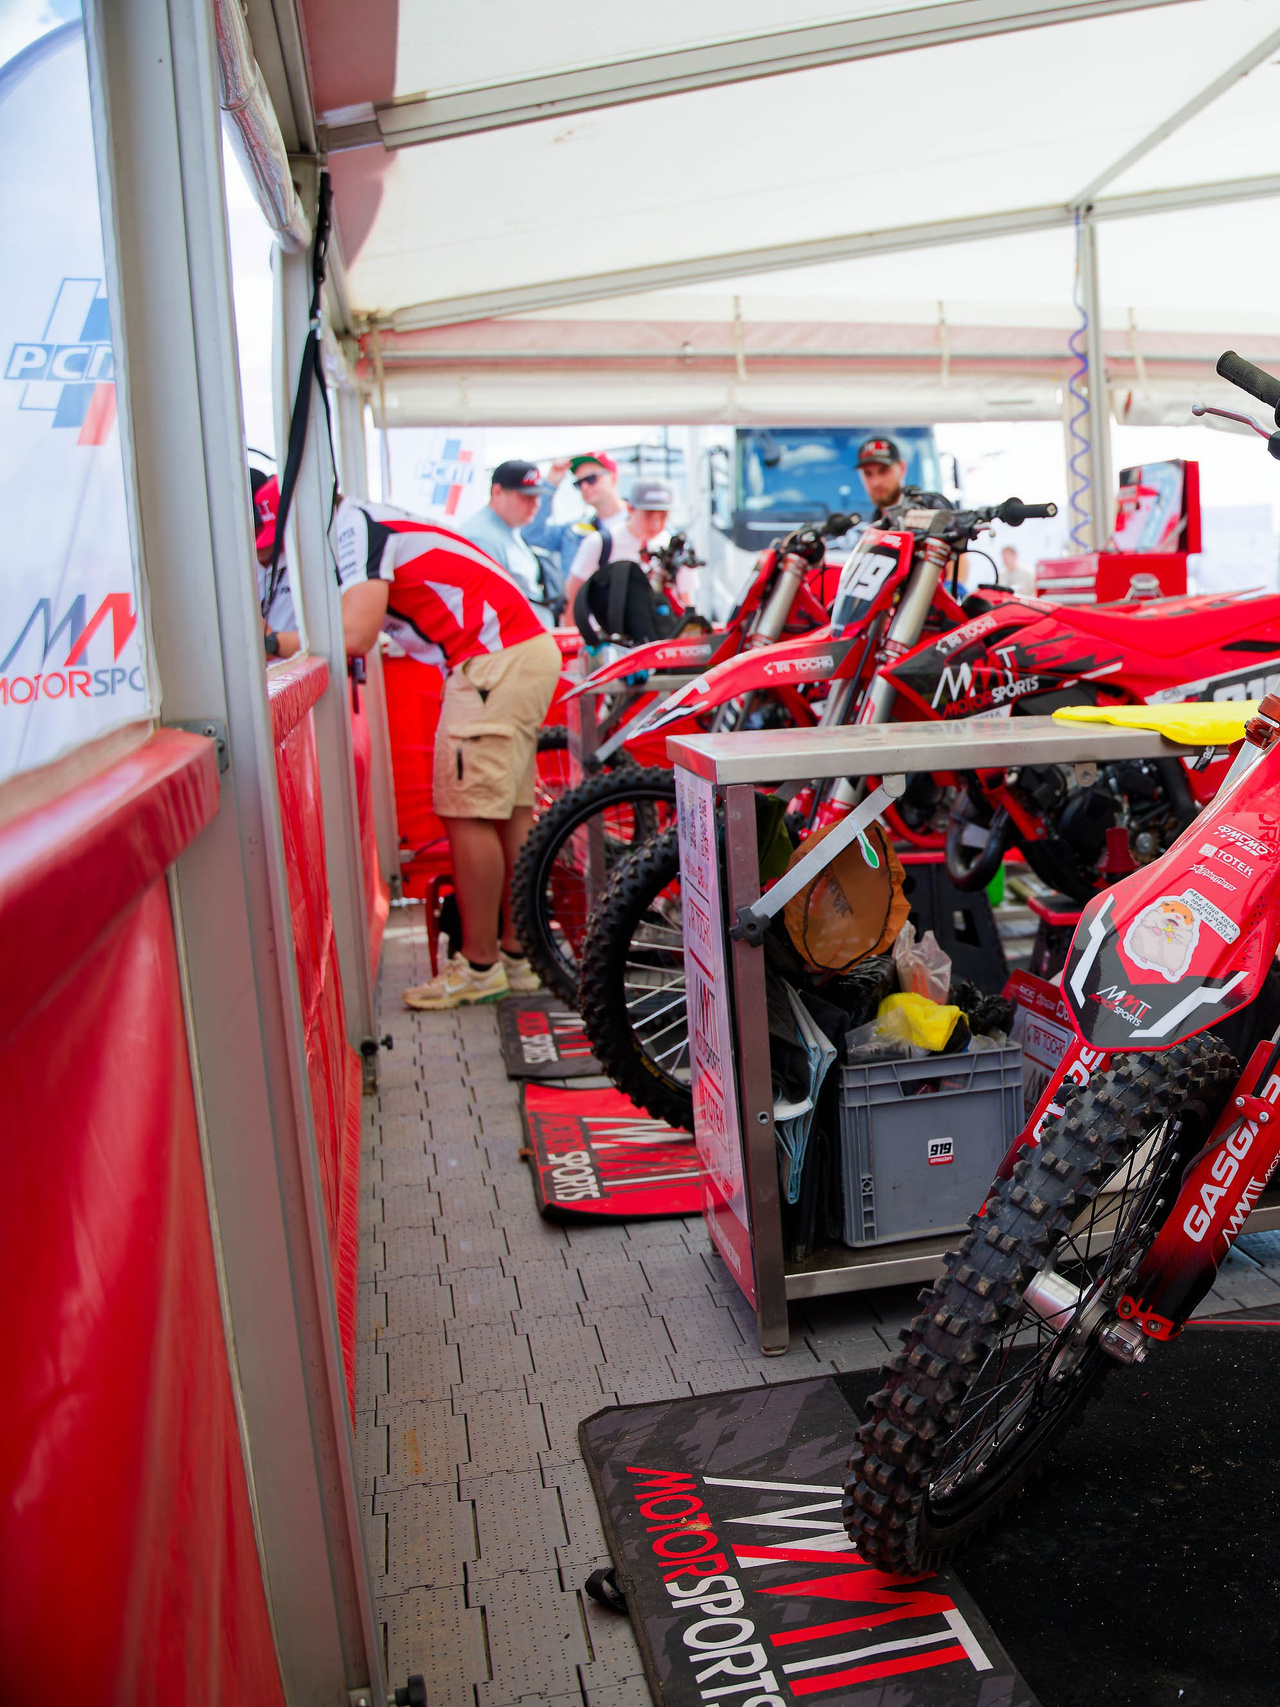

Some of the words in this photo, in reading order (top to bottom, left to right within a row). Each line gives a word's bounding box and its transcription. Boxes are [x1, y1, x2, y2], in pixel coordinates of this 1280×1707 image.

[1217, 849, 1255, 877] TOTEK
[1087, 993, 1142, 1027] MOTORSPORTS
[1096, 985, 1152, 1019] MMT
[930, 1142, 952, 1156] 919
